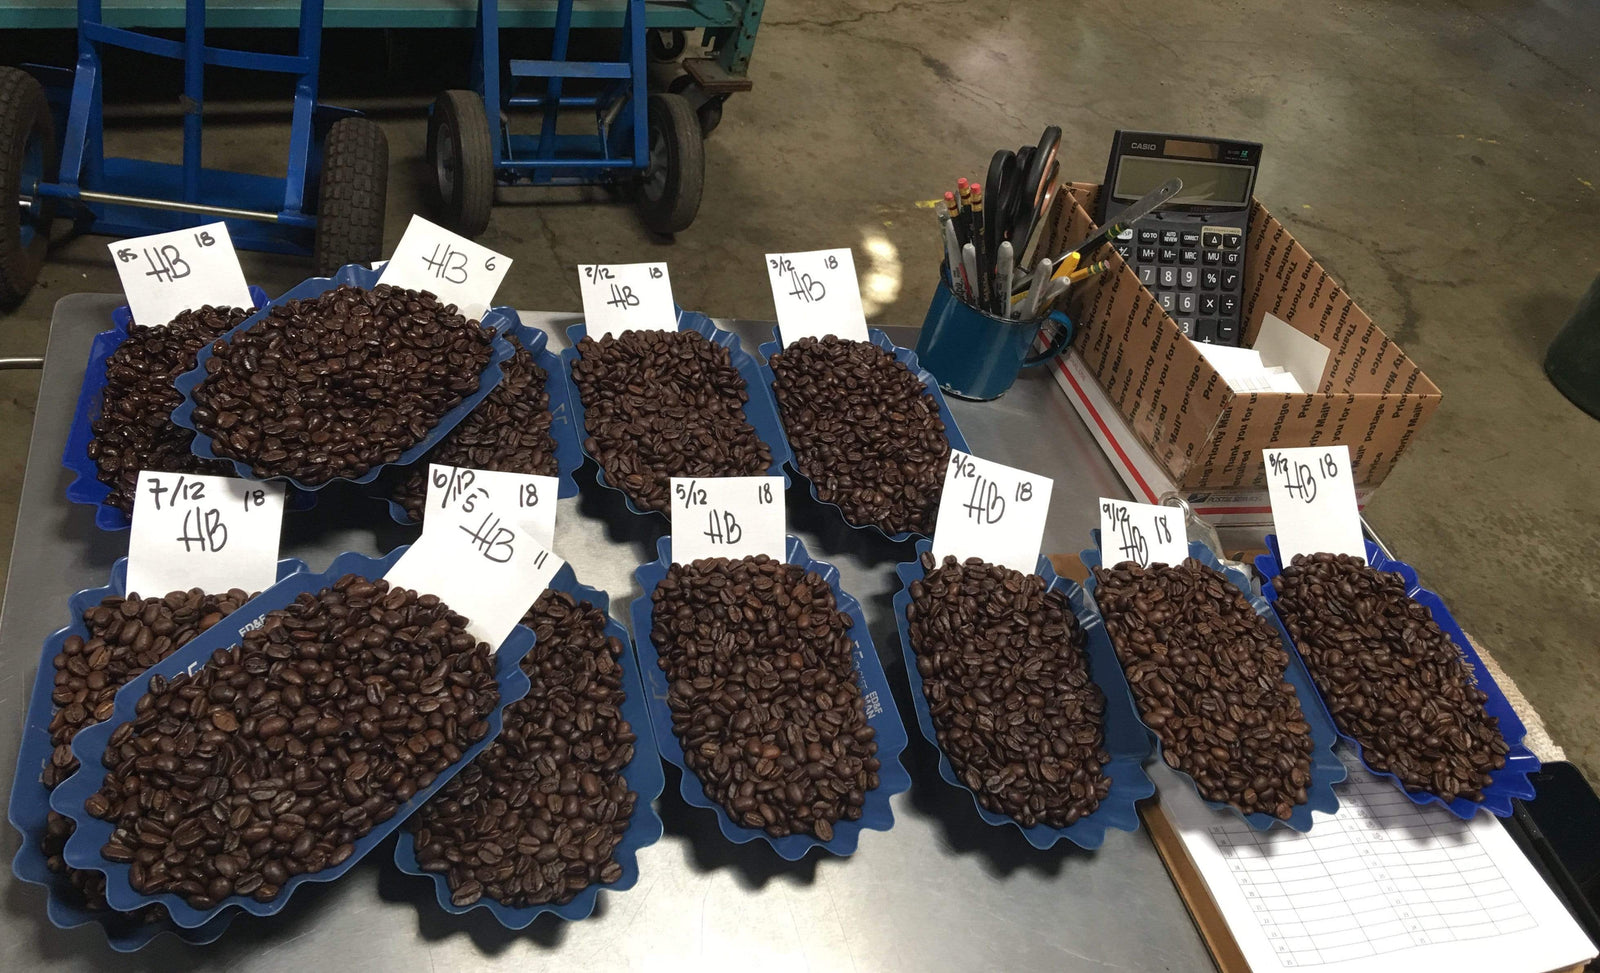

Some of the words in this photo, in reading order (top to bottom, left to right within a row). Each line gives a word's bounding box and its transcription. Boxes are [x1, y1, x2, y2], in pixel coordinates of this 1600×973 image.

[1131, 142, 1157, 151] CASIO
[193, 231, 216, 248] 18
[143, 244, 191, 283] HB
[421, 243, 468, 284] HB
[484, 256, 496, 271] 6
[769, 255, 796, 277] 3/12
[823, 254, 839, 270] 18
[1184, 251, 1197, 260] MRC
[1207, 252, 1220, 261] MU
[1228, 254, 1238, 262] GT
[584, 265, 616, 285] 2/12
[649, 266, 664, 280] 18
[789, 268, 826, 303] HB
[1144, 269, 1151, 281] 7
[1165, 270, 1172, 282] 8
[1186, 271, 1193, 283] 9
[1280, 260, 1298, 294] Thank
[606, 283, 641, 310] HB
[1164, 296, 1170, 307] 5
[1184, 297, 1191, 308] 6
[1247, 272, 1265, 315] postage
[1272, 294, 1284, 315] you
[1286, 281, 1307, 321] Priority
[1093, 319, 1108, 353] Thank
[1105, 296, 1115, 319] you
[1111, 275, 1121, 294] for
[1122, 294, 1141, 342] postage
[1182, 322, 1189, 334] 3
[1338, 322, 1358, 357] Thank
[1136, 355, 1155, 399] Priority
[1329, 357, 1342, 379] you
[1344, 346, 1367, 388] Priority
[1145, 386, 1162, 422] Thank
[1158, 363, 1170, 387] you
[1165, 342, 1177, 362] for
[1180, 364, 1201, 415] postage
[1241, 406, 1254, 423] for
[1269, 402, 1290, 443] postage
[1337, 406, 1351, 422] for
[1364, 403, 1385, 442] postage
[1236, 423, 1249, 442] you
[1223, 443, 1242, 475] Thank
[1319, 452, 1338, 479] 18
[147, 475, 206, 511] 7/12
[676, 480, 708, 509] 5/12
[758, 482, 773, 505] 18
[1015, 481, 1033, 502] 18
[1284, 460, 1317, 504] HB
[244, 489, 266, 512] 18
[519, 483, 539, 508] 18
[963, 474, 1006, 525] HB
[176, 506, 228, 553] HB
[458, 512, 516, 563] HB
[703, 508, 742, 545] HB
[1154, 514, 1172, 545] 18
[869, 690, 883, 714] ED&F
